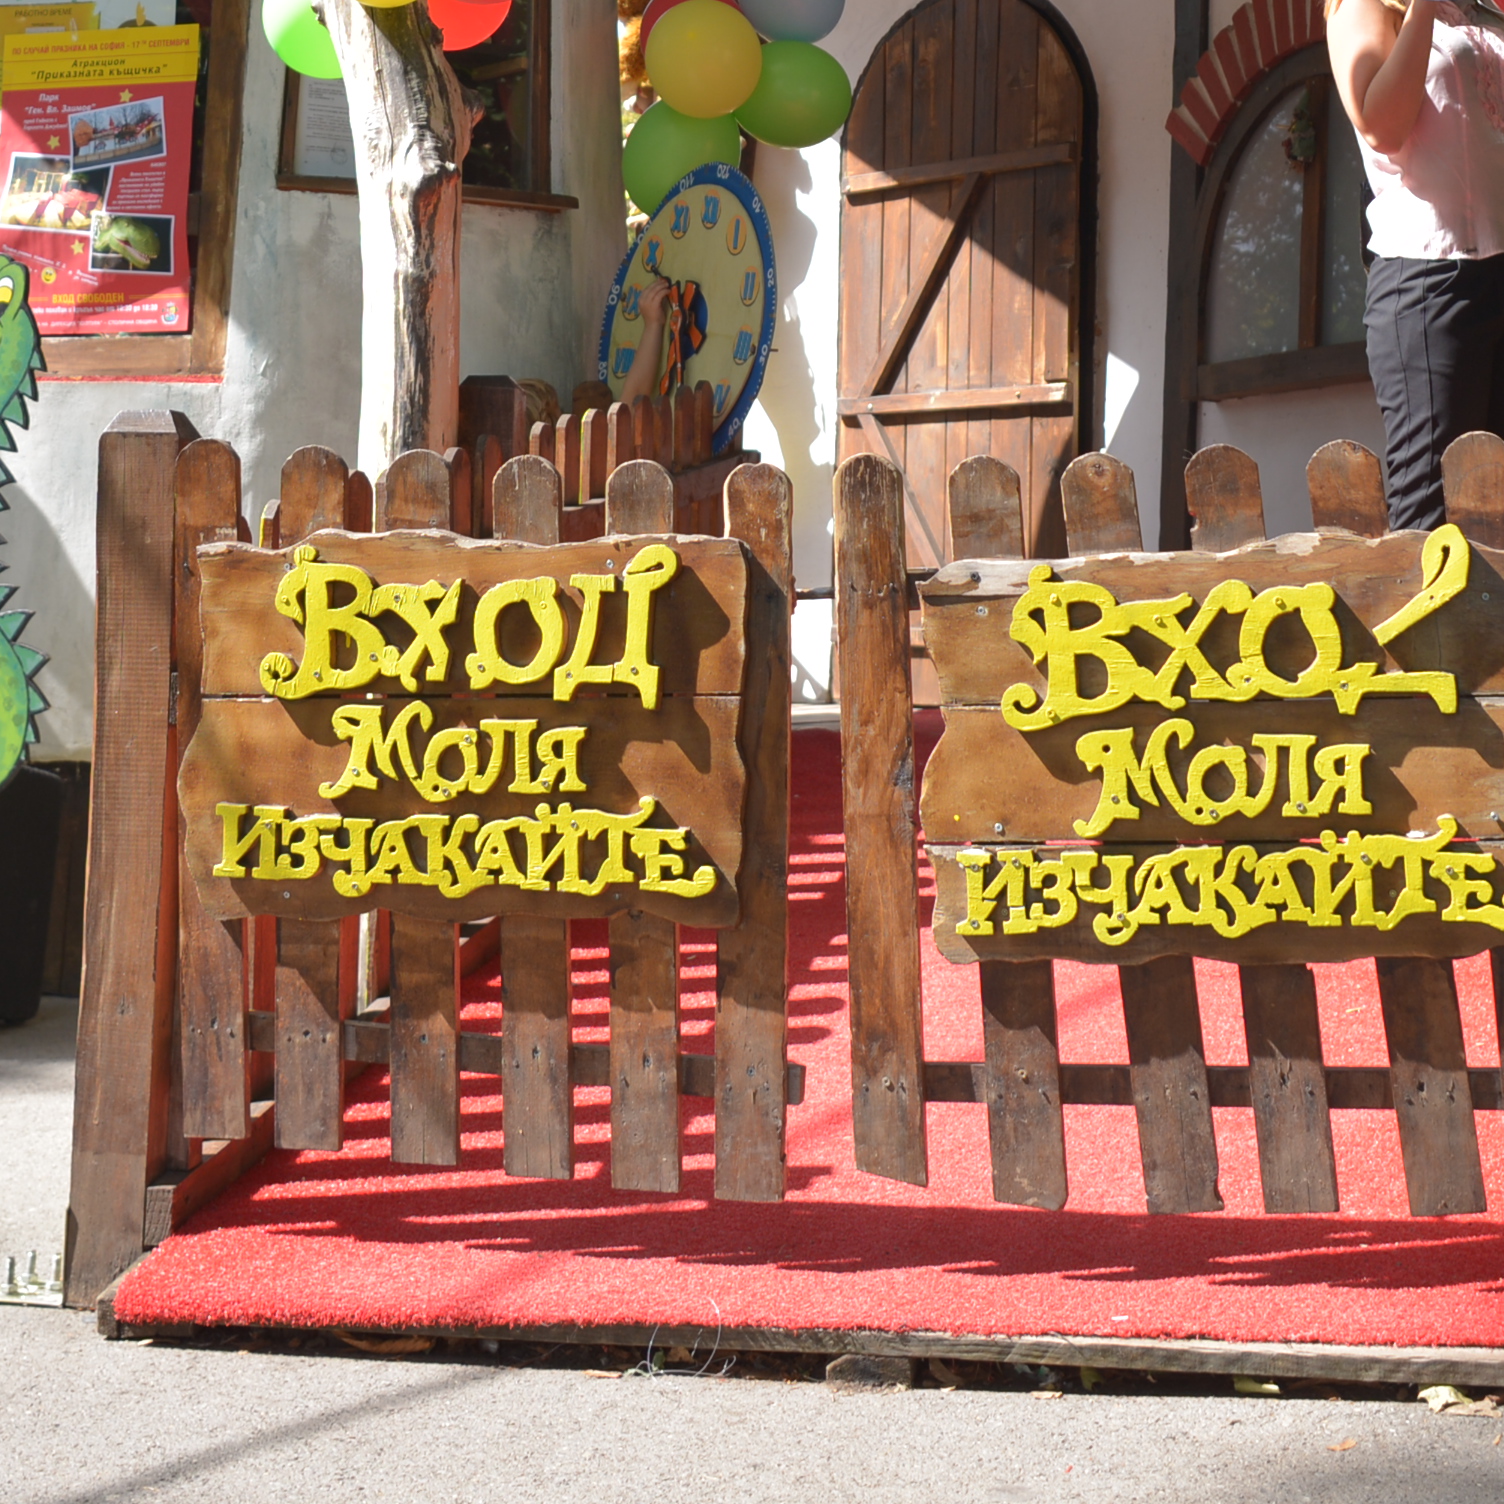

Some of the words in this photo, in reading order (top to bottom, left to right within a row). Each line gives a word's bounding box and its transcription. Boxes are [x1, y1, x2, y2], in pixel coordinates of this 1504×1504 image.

[14, 9, 48, 17] РАБОТНО
[71, 58, 126, 68] Атракцион
[767, 268, 774, 287] 20
[52, 294, 75, 304] ВХОД
[77, 293, 124, 303] СВОБОДЕН
[608, 284, 620, 305] 90
[759, 344, 768, 366] 30
[259, 544, 683, 710] ВХОД
[212, 796, 718, 898] ИЗЧАКАЙТЕ
